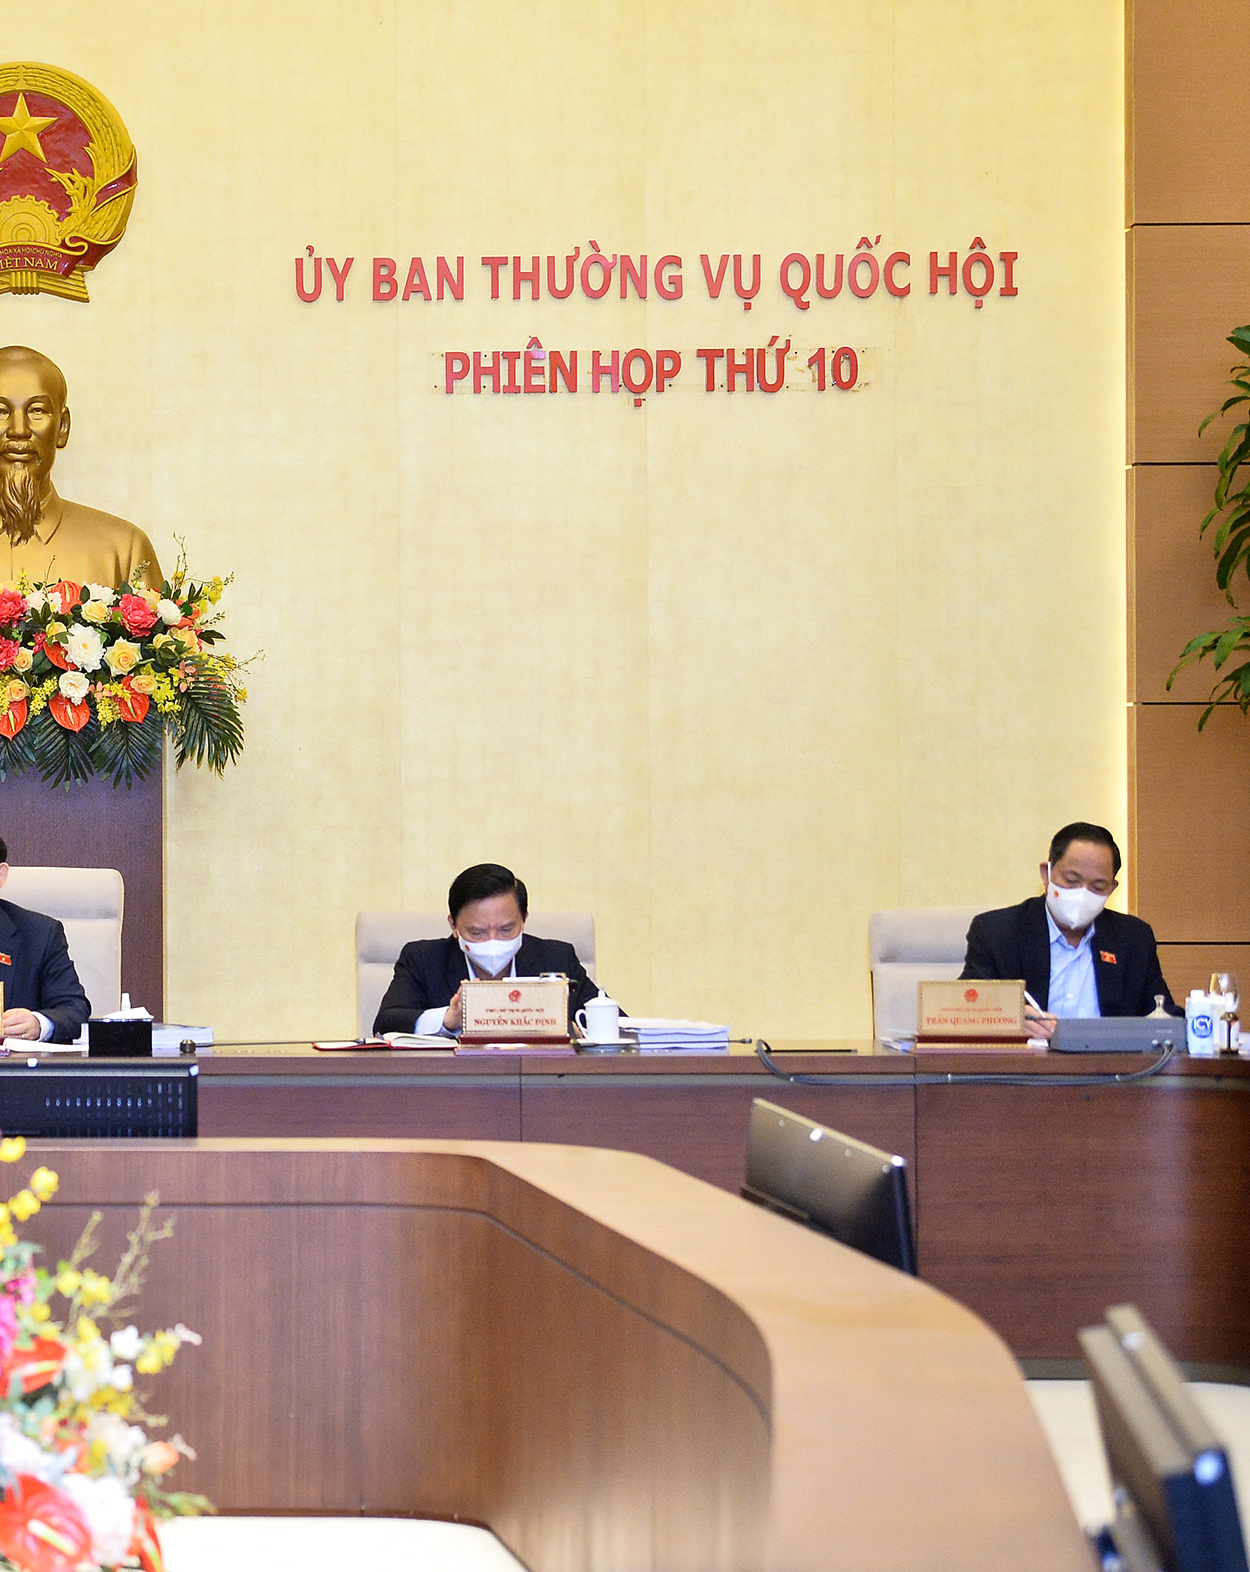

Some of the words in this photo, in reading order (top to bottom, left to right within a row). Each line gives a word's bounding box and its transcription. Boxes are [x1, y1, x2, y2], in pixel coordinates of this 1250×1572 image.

[23, 257, 58, 271] NAM
[294, 245, 354, 301] ỦY
[372, 256, 464, 301] BAN
[482, 240, 683, 301] THƯỜNG
[700, 254, 761, 310] VỤ
[779, 235, 911, 310] QUỐC
[929, 237, 1018, 309] HỘI
[446, 337, 577, 393] PHIÊN
[592, 347, 681, 407] HỌP
[696, 336, 791, 393] THỨ
[808, 347, 858, 391] 10
[1194, 1019, 1211, 1030] ICY
